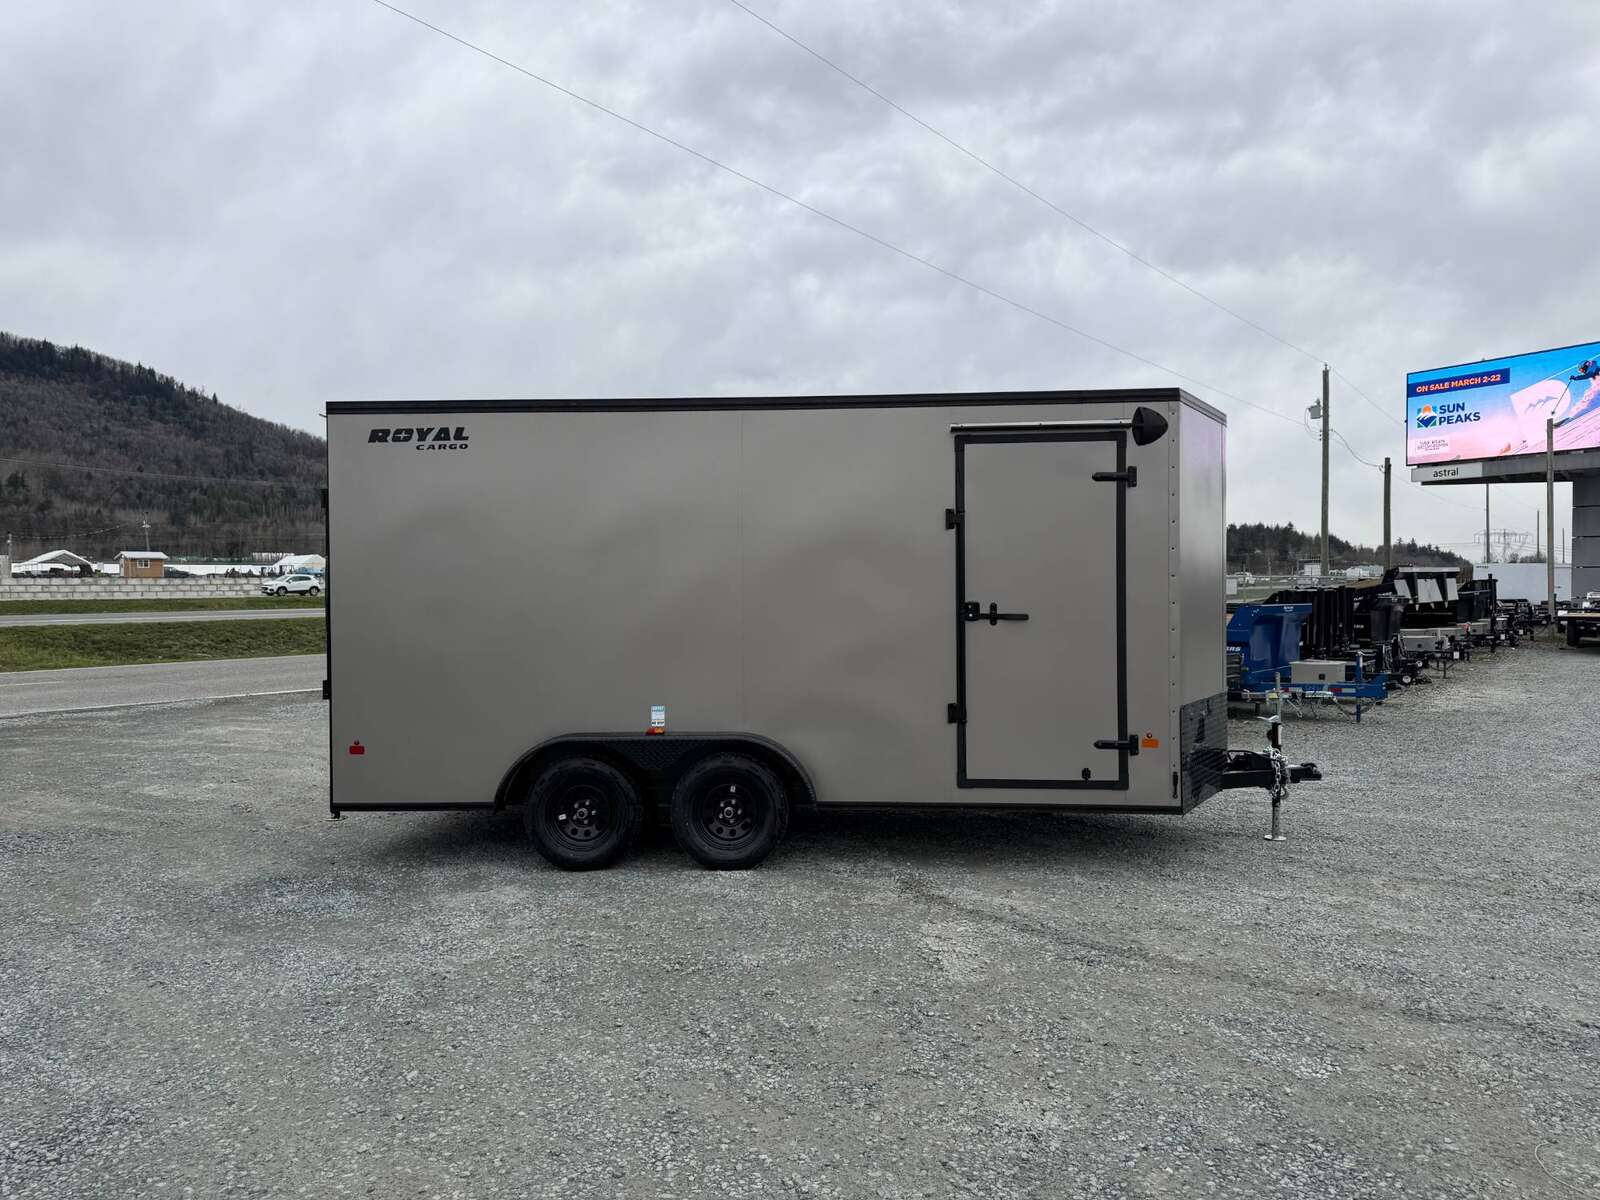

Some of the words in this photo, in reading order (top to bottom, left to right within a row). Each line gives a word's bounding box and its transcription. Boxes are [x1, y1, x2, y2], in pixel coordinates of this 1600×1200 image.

[1416, 385, 1428, 393] ON
[1430, 381, 1449, 392] SALE
[1451, 377, 1481, 388] MARCH
[1483, 374, 1501, 384] 2-22
[1439, 402, 1465, 414] SUN
[1439, 412, 1480, 426] PEAKS
[368, 427, 469, 443] ROYAL
[1433, 467, 1459, 478] astral
